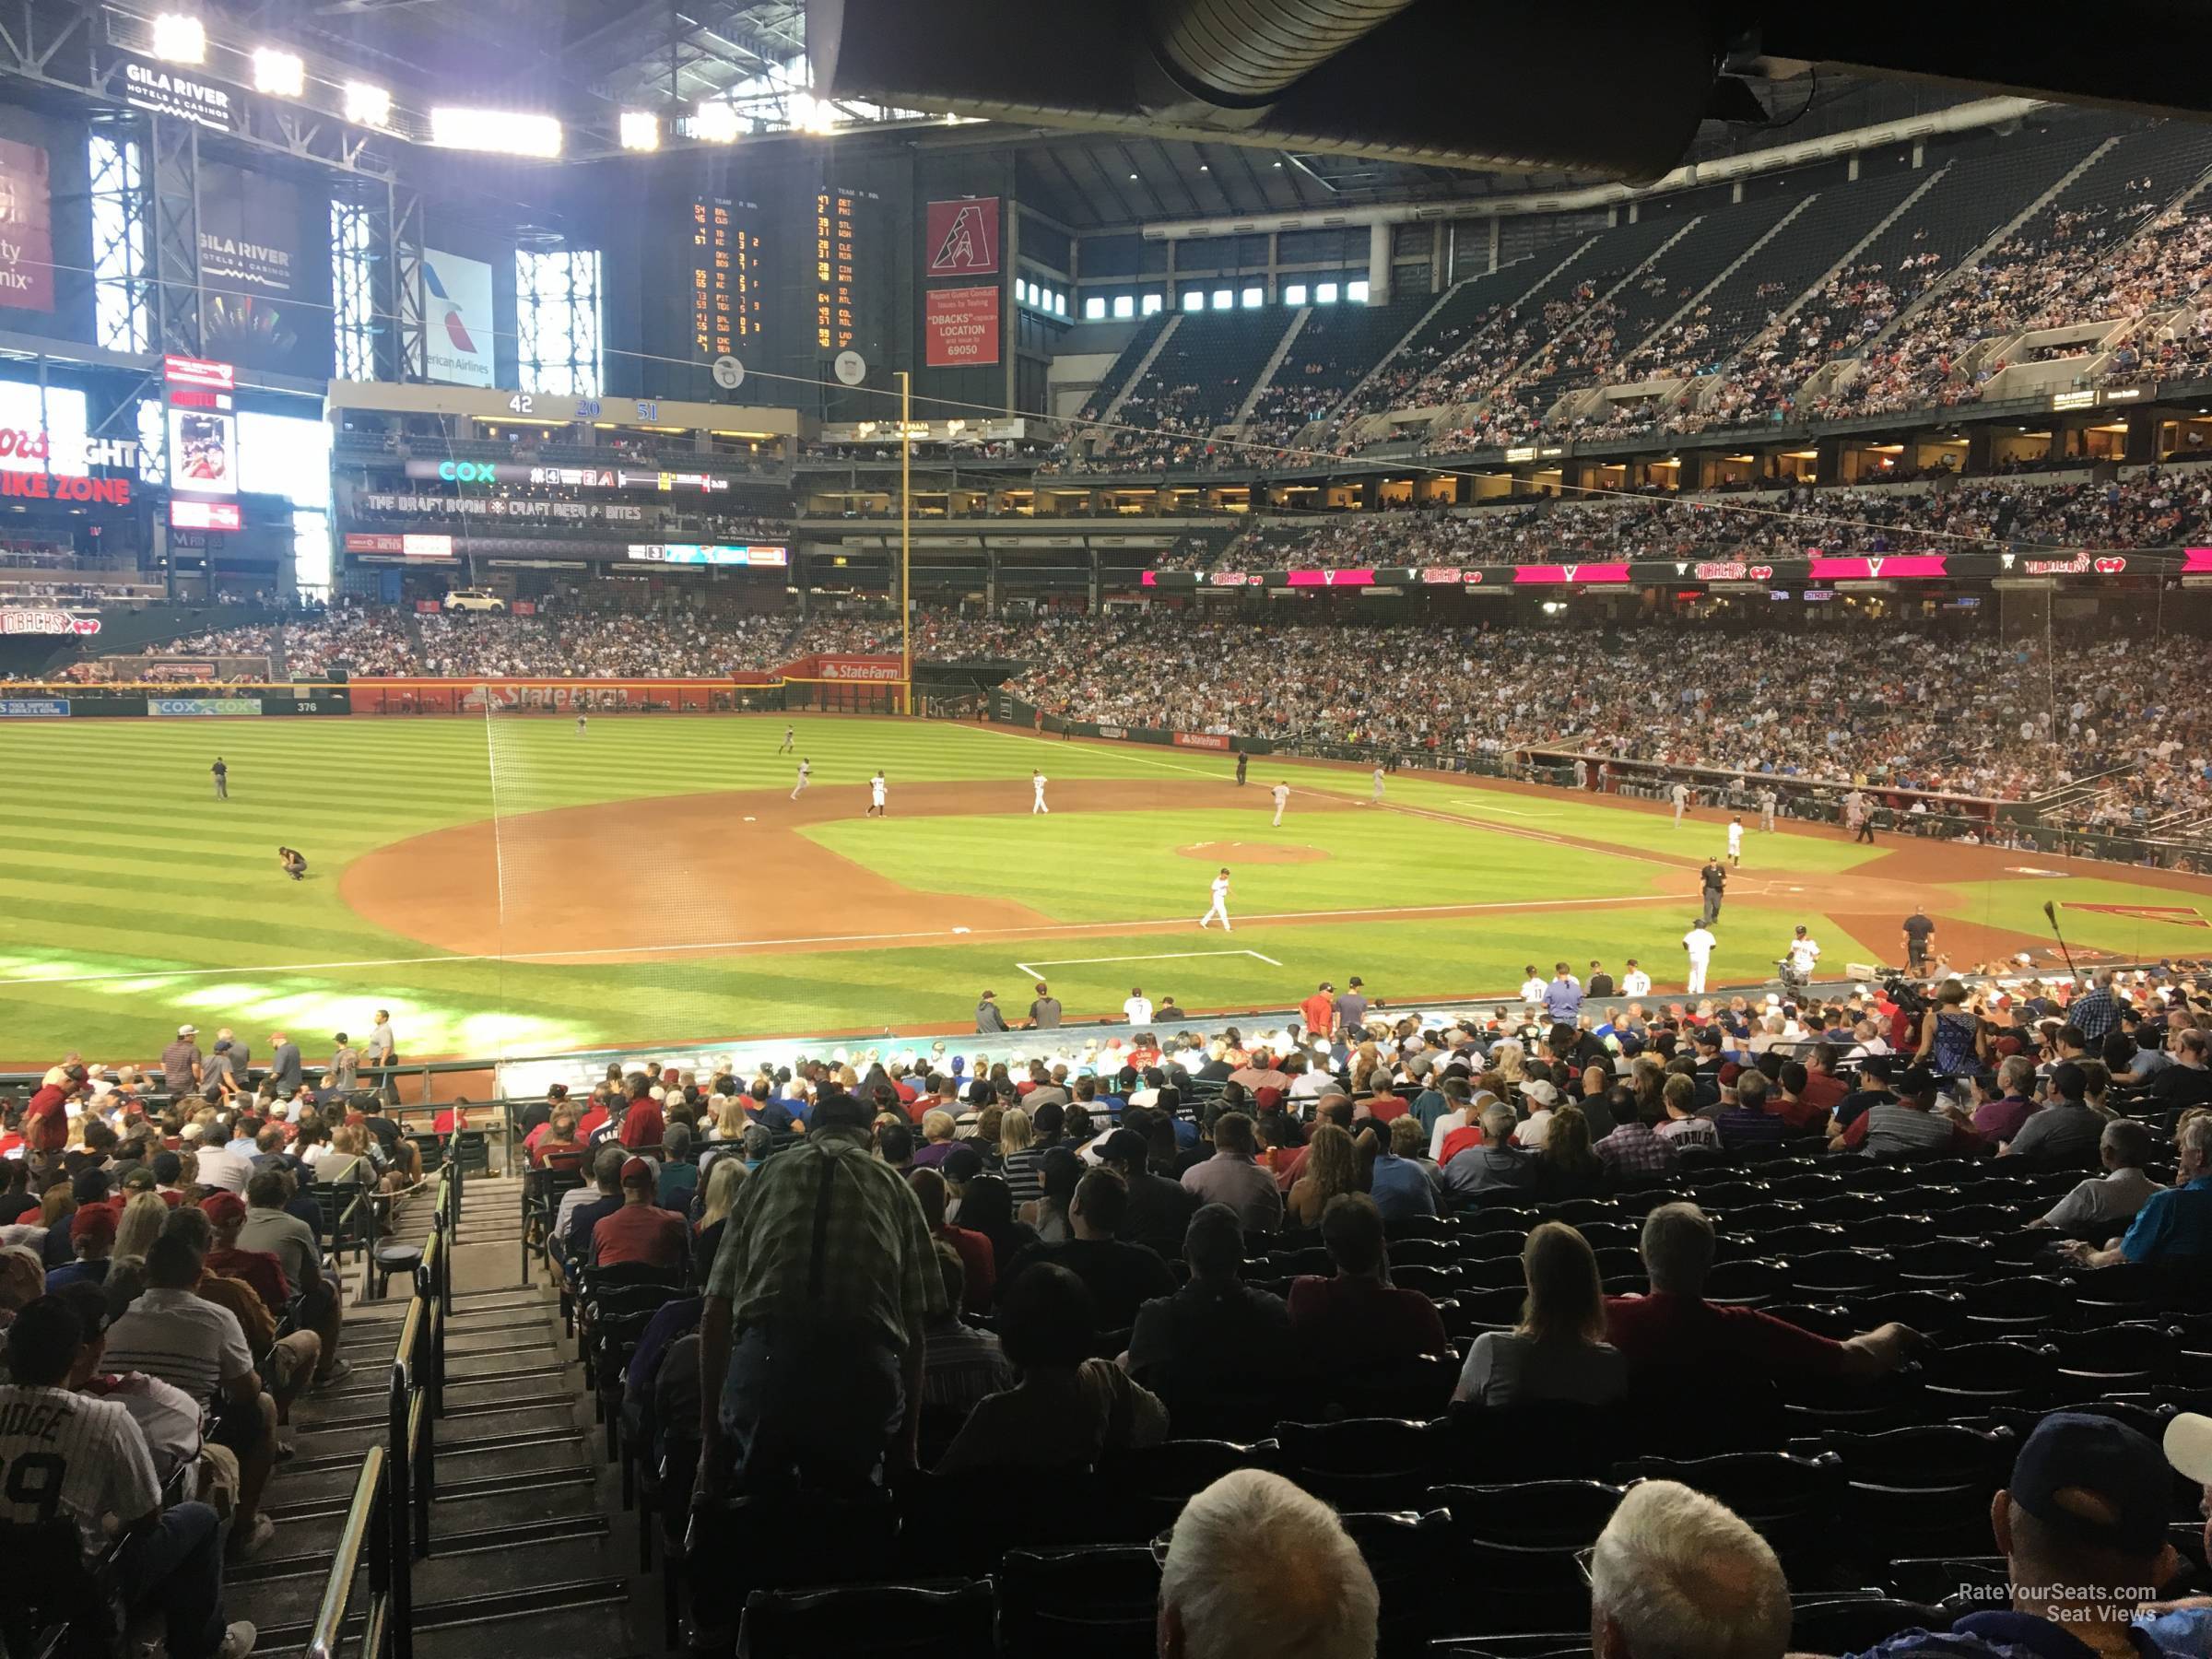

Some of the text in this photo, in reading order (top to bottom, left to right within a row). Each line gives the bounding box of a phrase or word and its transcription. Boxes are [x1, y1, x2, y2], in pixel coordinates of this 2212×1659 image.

[127, 65, 229, 108] GILA RIVER
[127, 84, 169, 101] HOTELS
[184, 100, 229, 119] CASINOS
[818, 194, 830, 205] 47
[695, 205, 706, 214] 54
[818, 205, 824, 213] 2
[818, 227, 830, 236] 31
[695, 236, 706, 245] 57
[200, 232, 289, 266] GILA RIVER
[818, 250, 830, 259] 31
[203, 253, 233, 265] OTELS
[249, 263, 290, 276] CASINOS
[818, 293, 830, 302] 64
[818, 316, 830, 324] 57
[940, 324, 985, 336] LOCATION
[947, 345, 978, 356] 69050
[455, 358, 488, 374] Airlines
[509, 395, 533, 412] 42
[575, 400, 602, 417] 20
[638, 403, 657, 420] 51
[439, 461, 496, 482] COX
[54, 473, 131, 504] ZONE
[368, 495, 394, 510] THE
[398, 497, 443, 512] DRAFT
[446, 499, 487, 513] ROOM
[509, 501, 550, 516] CRAFT
[553, 503, 587, 518] BEER
[605, 505, 641, 520] BITES
[161, 701, 195, 712] COX
[216, 701, 250, 712] COX
[297, 702, 317, 712] 376
[1636, 981, 1646, 993] 17
[1137, 1004, 1144, 1015] 7
